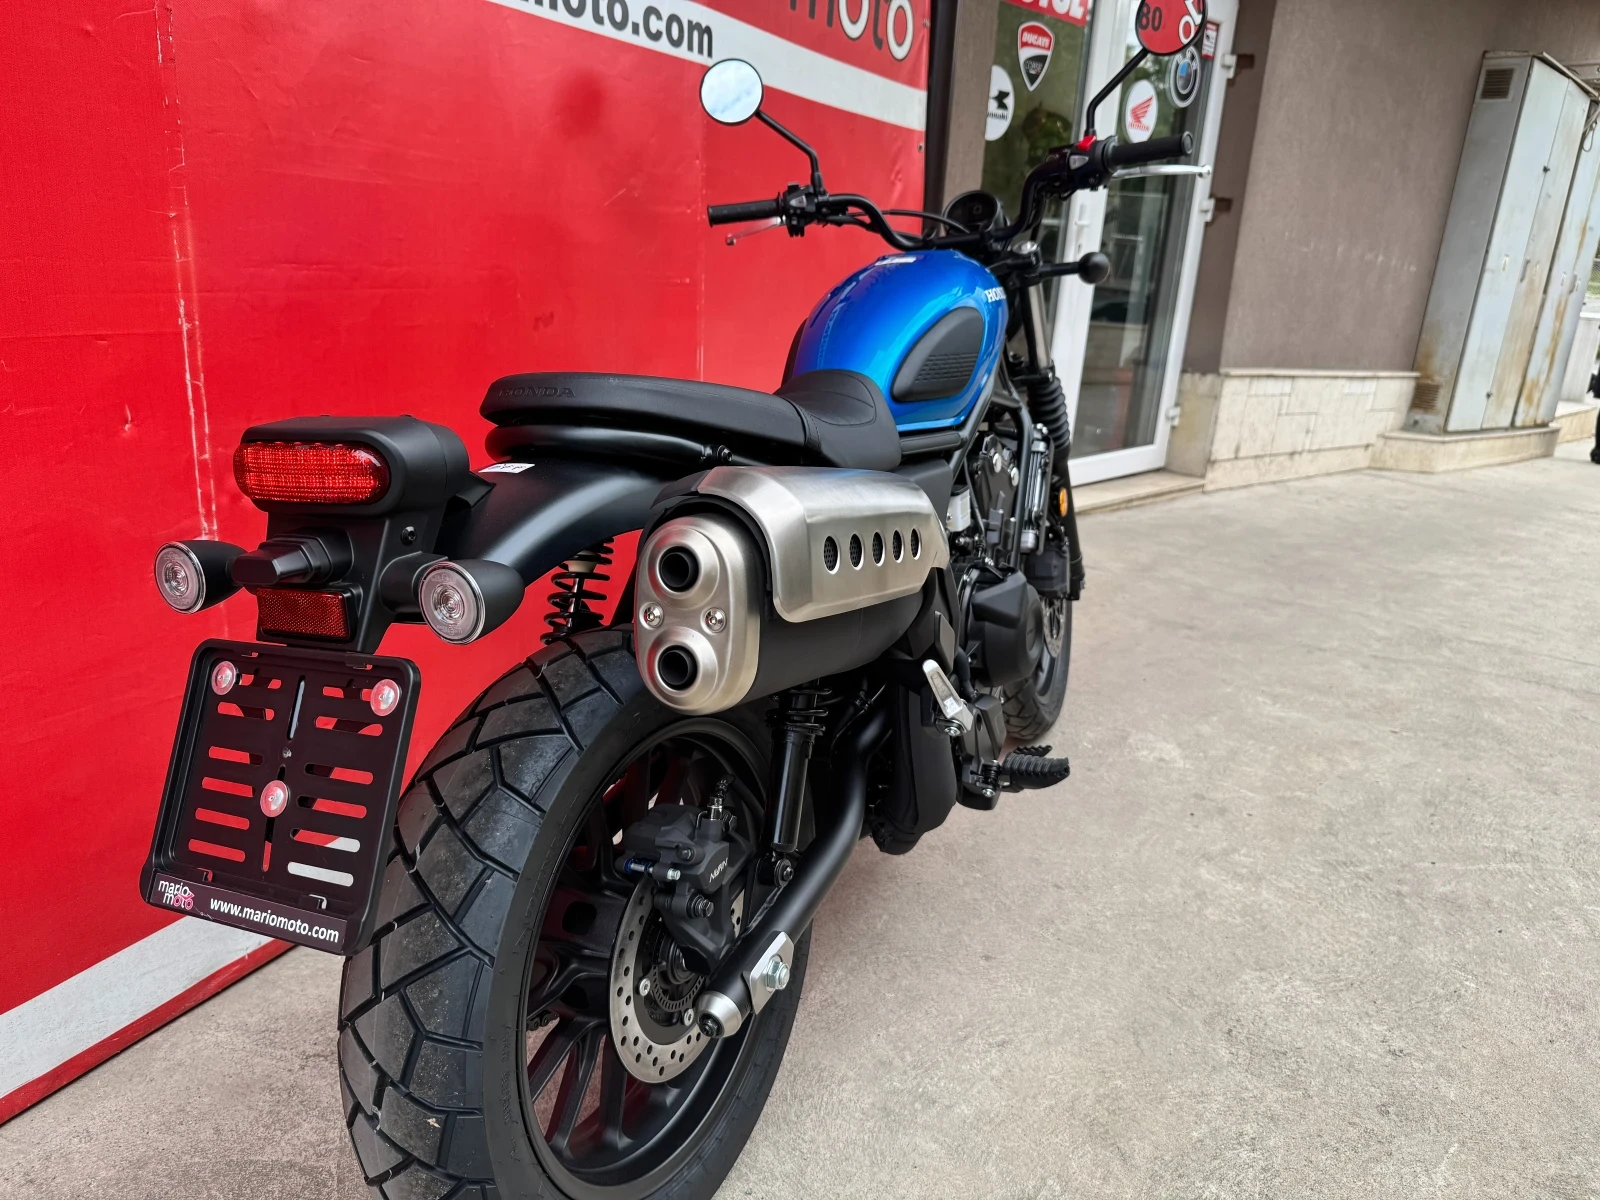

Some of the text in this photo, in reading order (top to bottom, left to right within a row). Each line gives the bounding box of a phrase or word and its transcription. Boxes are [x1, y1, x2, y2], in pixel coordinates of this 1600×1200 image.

[1021, 31, 1050, 48] DUCATI
[158, 880, 190, 896] mario
[162, 892, 194, 911] moto
[209, 897, 340, 943] www.mariomoto.com
